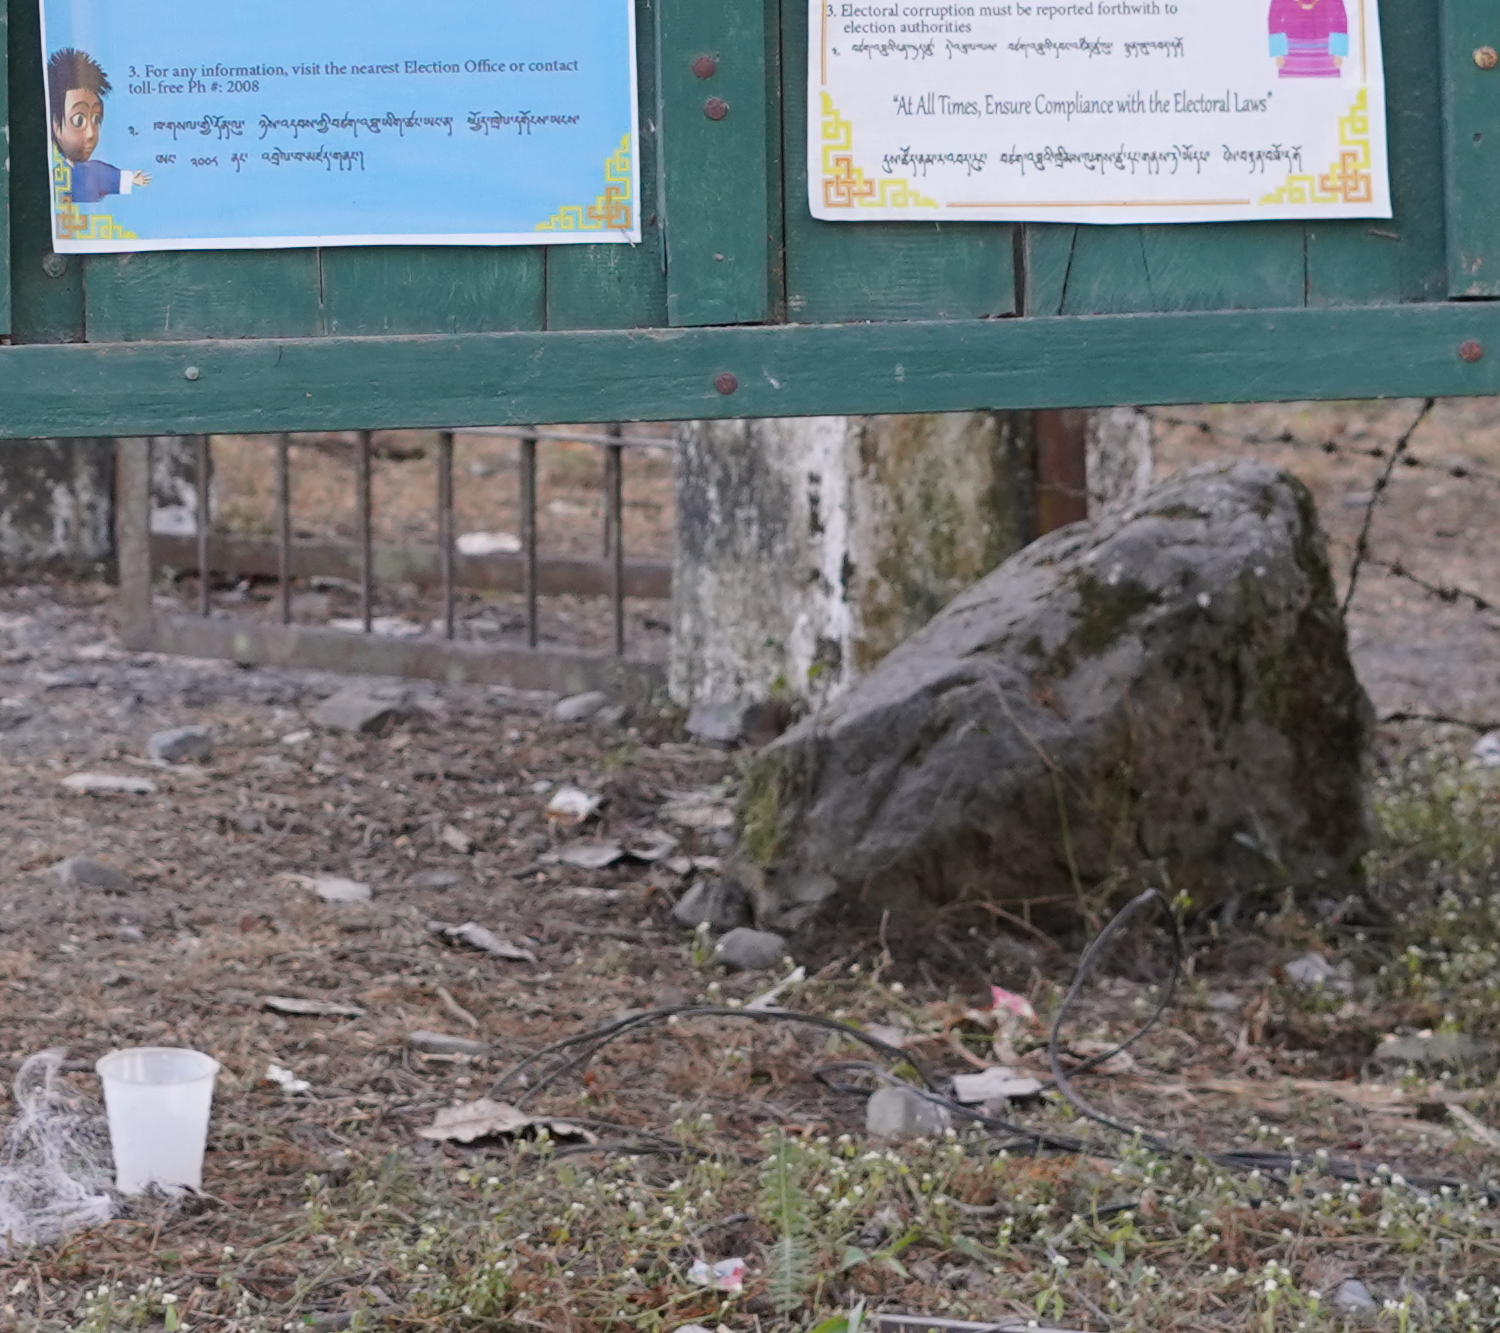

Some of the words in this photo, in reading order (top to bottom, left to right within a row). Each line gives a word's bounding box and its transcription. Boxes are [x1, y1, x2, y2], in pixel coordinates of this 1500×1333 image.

[825, 4, 838, 18] 3.
[840, 2, 899, 21] Electoral
[901, 3, 975, 21] corruption
[979, 4, 1012, 16] must
[1015, 1, 1032, 16] be
[1035, 1, 1093, 20] reported
[1097, 0, 1160, 15] forthwith
[1164, 2, 1178, 15] to
[842, 19, 896, 34] election
[899, 19, 972, 33] authorities
[915, 91, 936, 115] All
[937, 93, 982, 117] Times,
[984, 93, 1032, 115] Ensure
[1034, 90, 1114, 121] Compliance
[1115, 89, 1146, 114] with
[1148, 89, 1170, 113] the
[1172, 88, 1230, 113] Electoral
